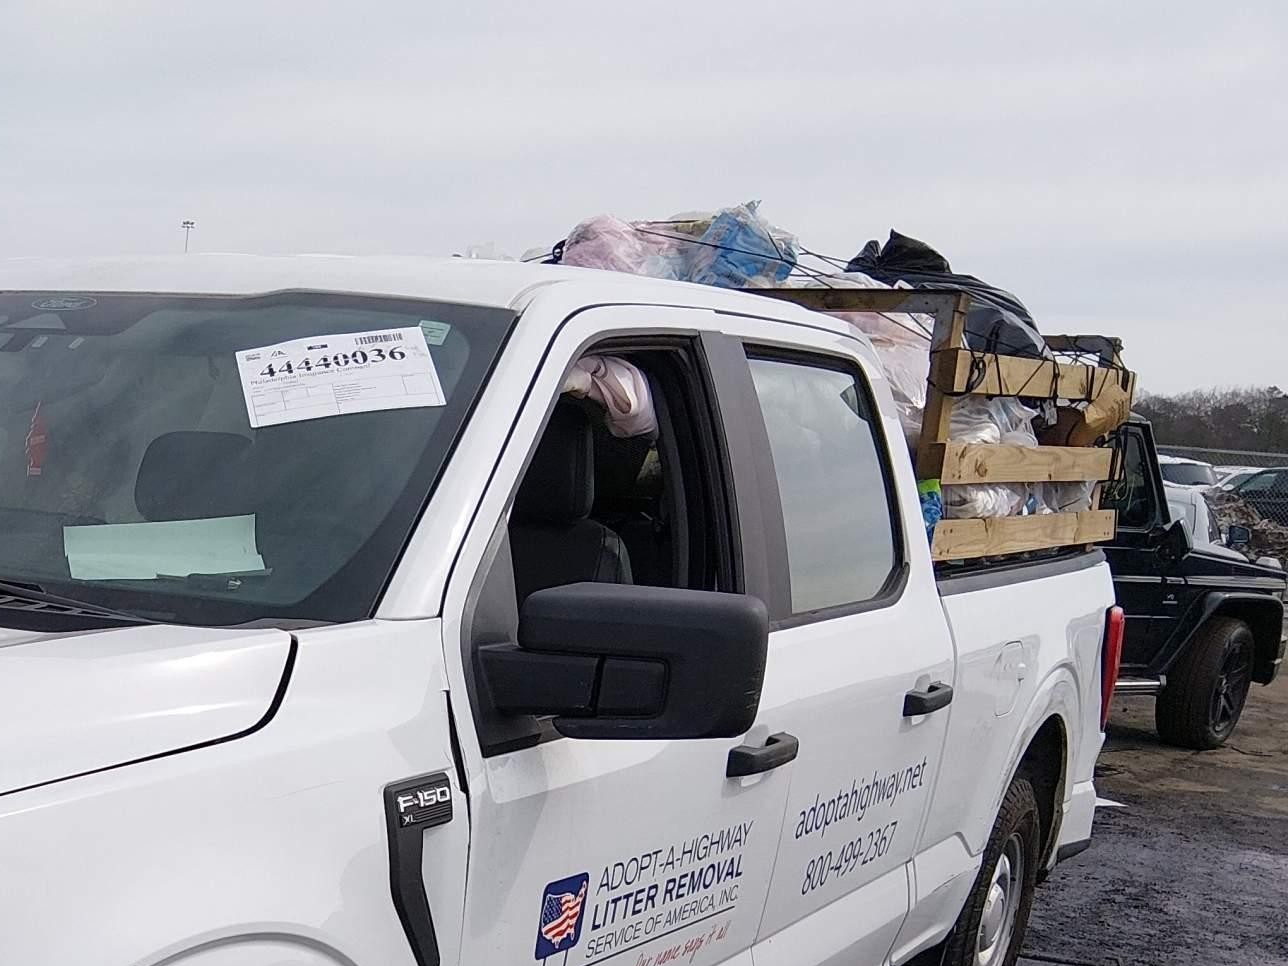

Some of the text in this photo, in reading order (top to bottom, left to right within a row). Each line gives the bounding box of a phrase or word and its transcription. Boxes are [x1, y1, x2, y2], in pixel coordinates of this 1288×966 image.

[259, 346, 406, 378] 44440036
[397, 786, 451, 813] F-150
[402, 814, 416, 826] XL
[795, 756, 927, 838] adoptahighway.net
[596, 819, 754, 897] ADOPT-A-HIGHWAY
[801, 820, 898, 896] 800-499-2367
[590, 854, 743, 932] LITTER REMOVAL
[585, 920, 643, 959] SERVICE
[644, 912, 663, 935] OF
[681, 933, 704, 964] says
[715, 919, 732, 942] all
